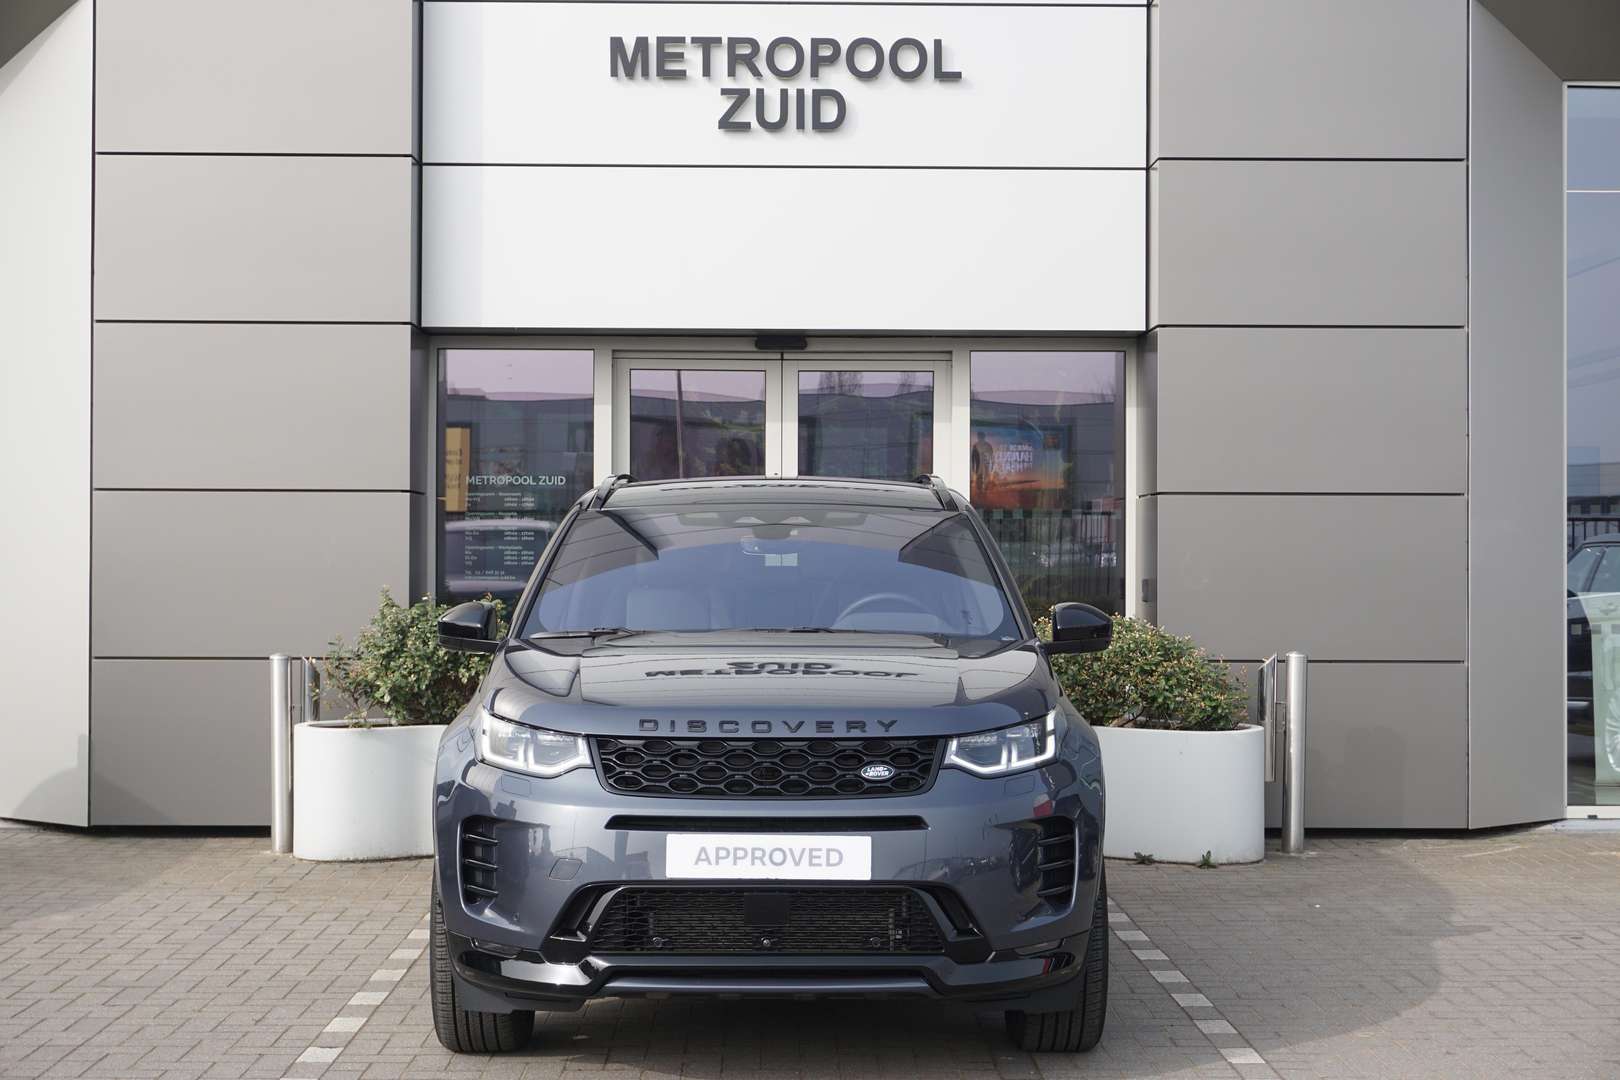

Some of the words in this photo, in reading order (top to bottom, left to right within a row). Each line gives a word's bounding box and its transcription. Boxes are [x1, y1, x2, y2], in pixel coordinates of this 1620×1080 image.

[610, 36, 962, 80] METROPOOL
[718, 88, 847, 131] ZUID
[466, 476, 536, 486] METROPOOL
[538, 476, 566, 486] ZUID
[639, 719, 898, 734] DISCOVERY
[694, 846, 843, 867] APPROVED
